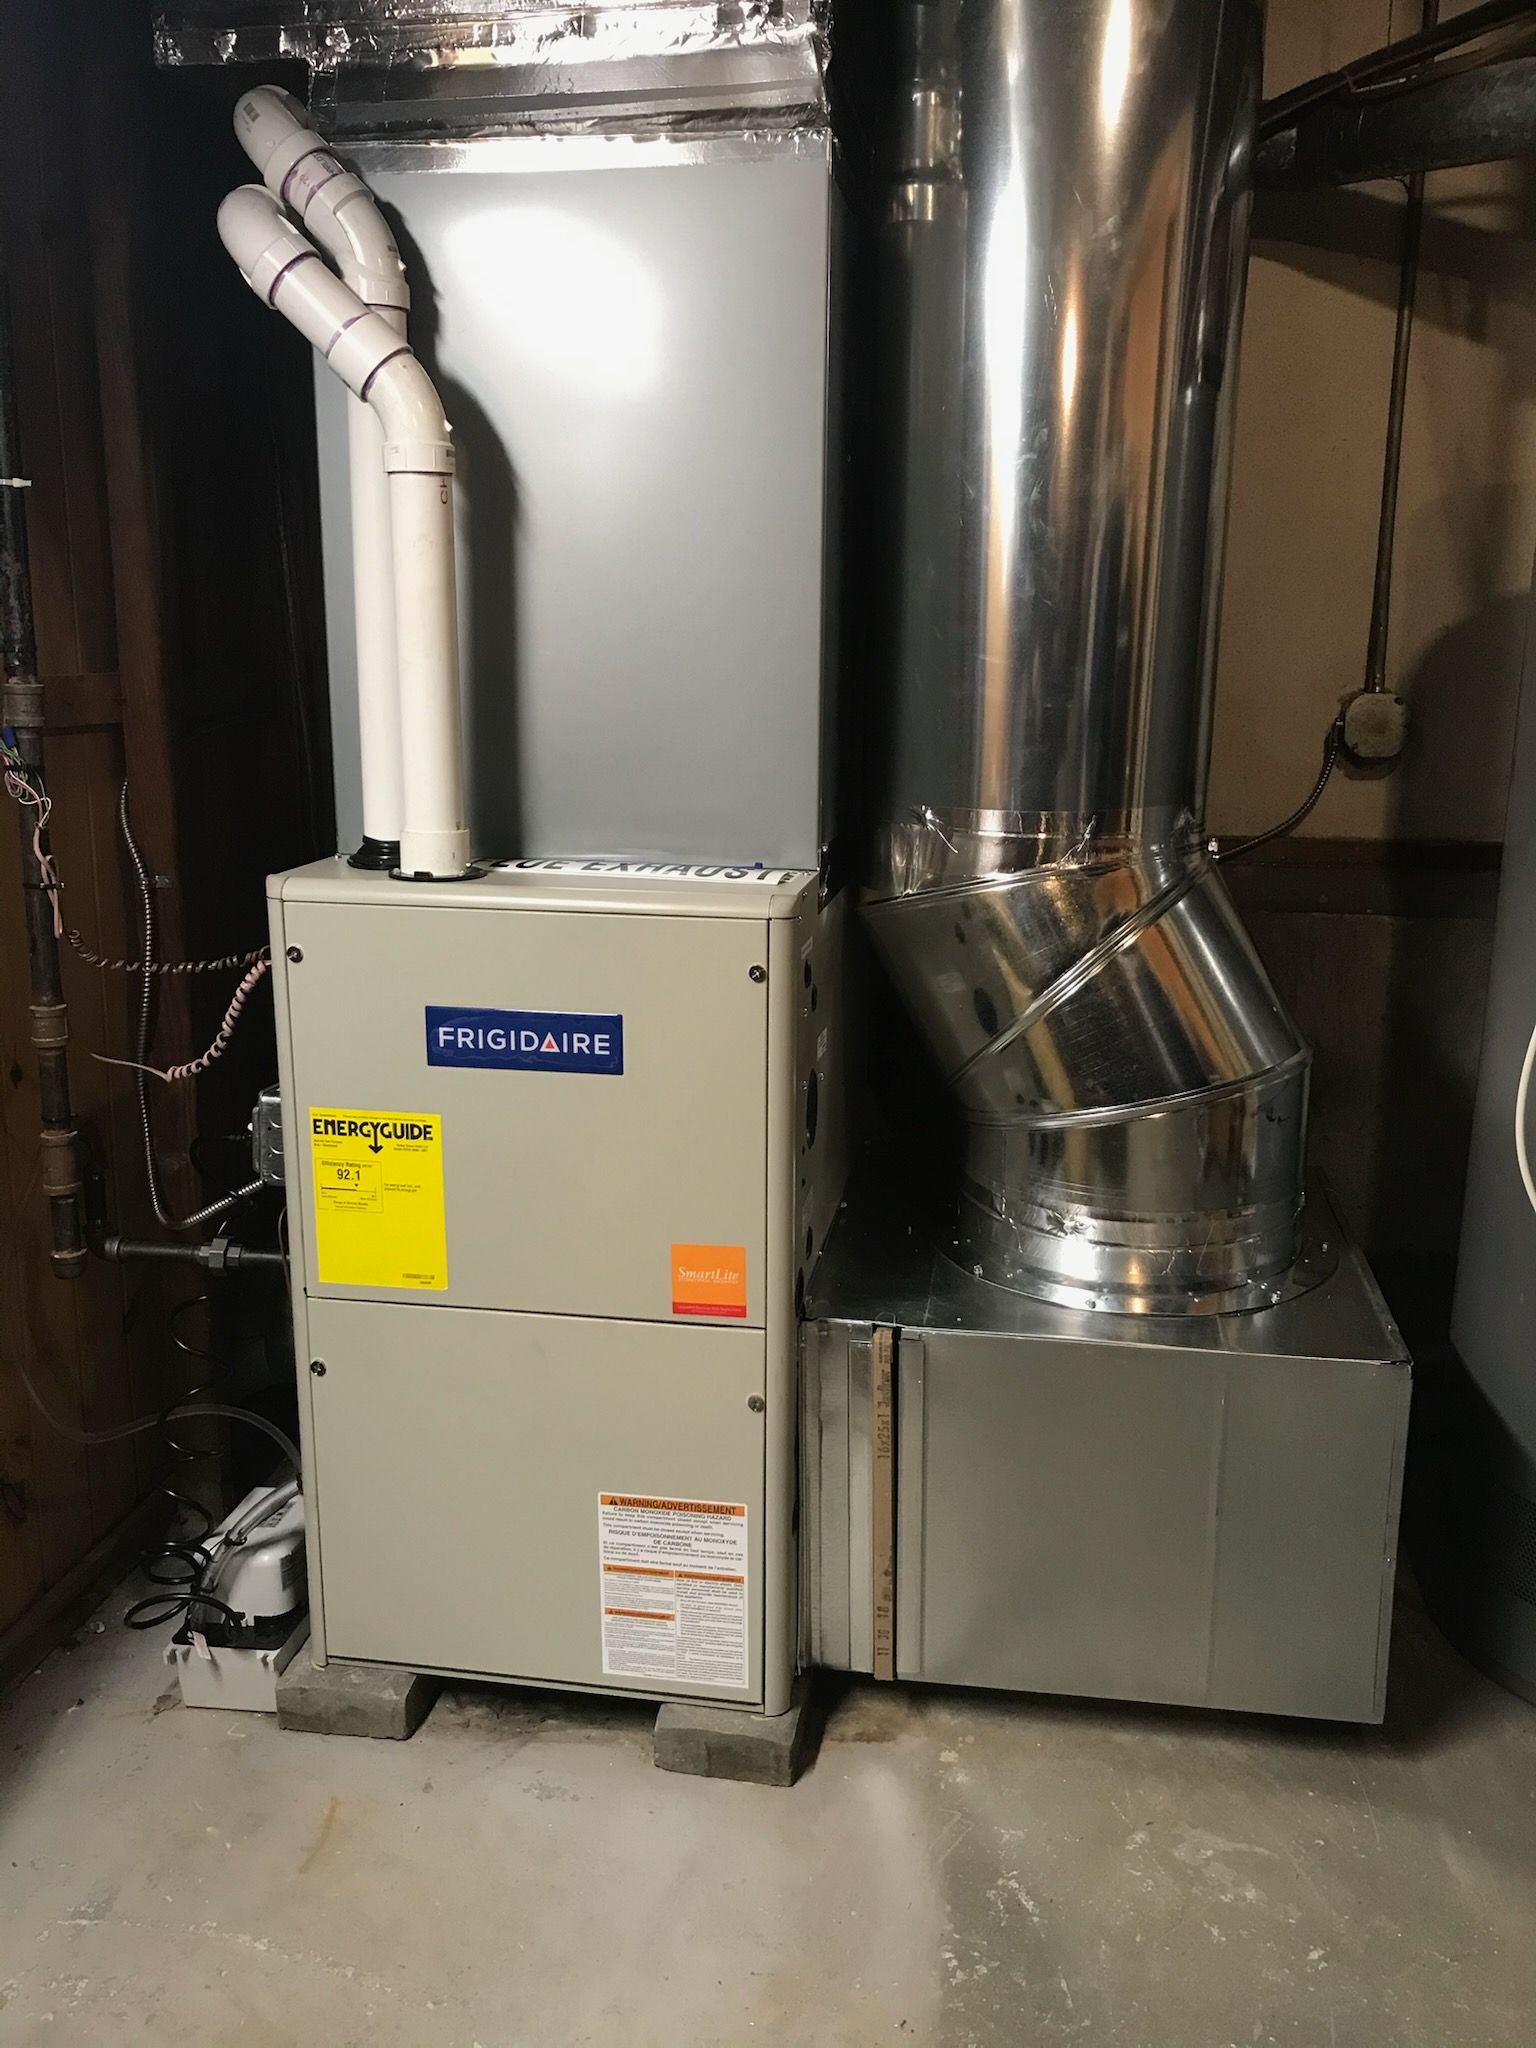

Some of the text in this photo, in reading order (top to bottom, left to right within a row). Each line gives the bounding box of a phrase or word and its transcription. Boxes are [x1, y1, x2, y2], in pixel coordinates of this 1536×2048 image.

[438, 1027, 610, 1056] FRIGIDAIRE
[313, 1118, 433, 1141] ENERGYGUIDE
[346, 1161, 361, 1169] Rating
[337, 1168, 360, 1181] 92.1
[678, 1266, 740, 1281] SmartLite
[877, 1414, 891, 1460] 16x25x1
[620, 1496, 736, 1515] WARNING/ADVERTISSEMENT
[703, 1537, 737, 1545] MONOXYDE
